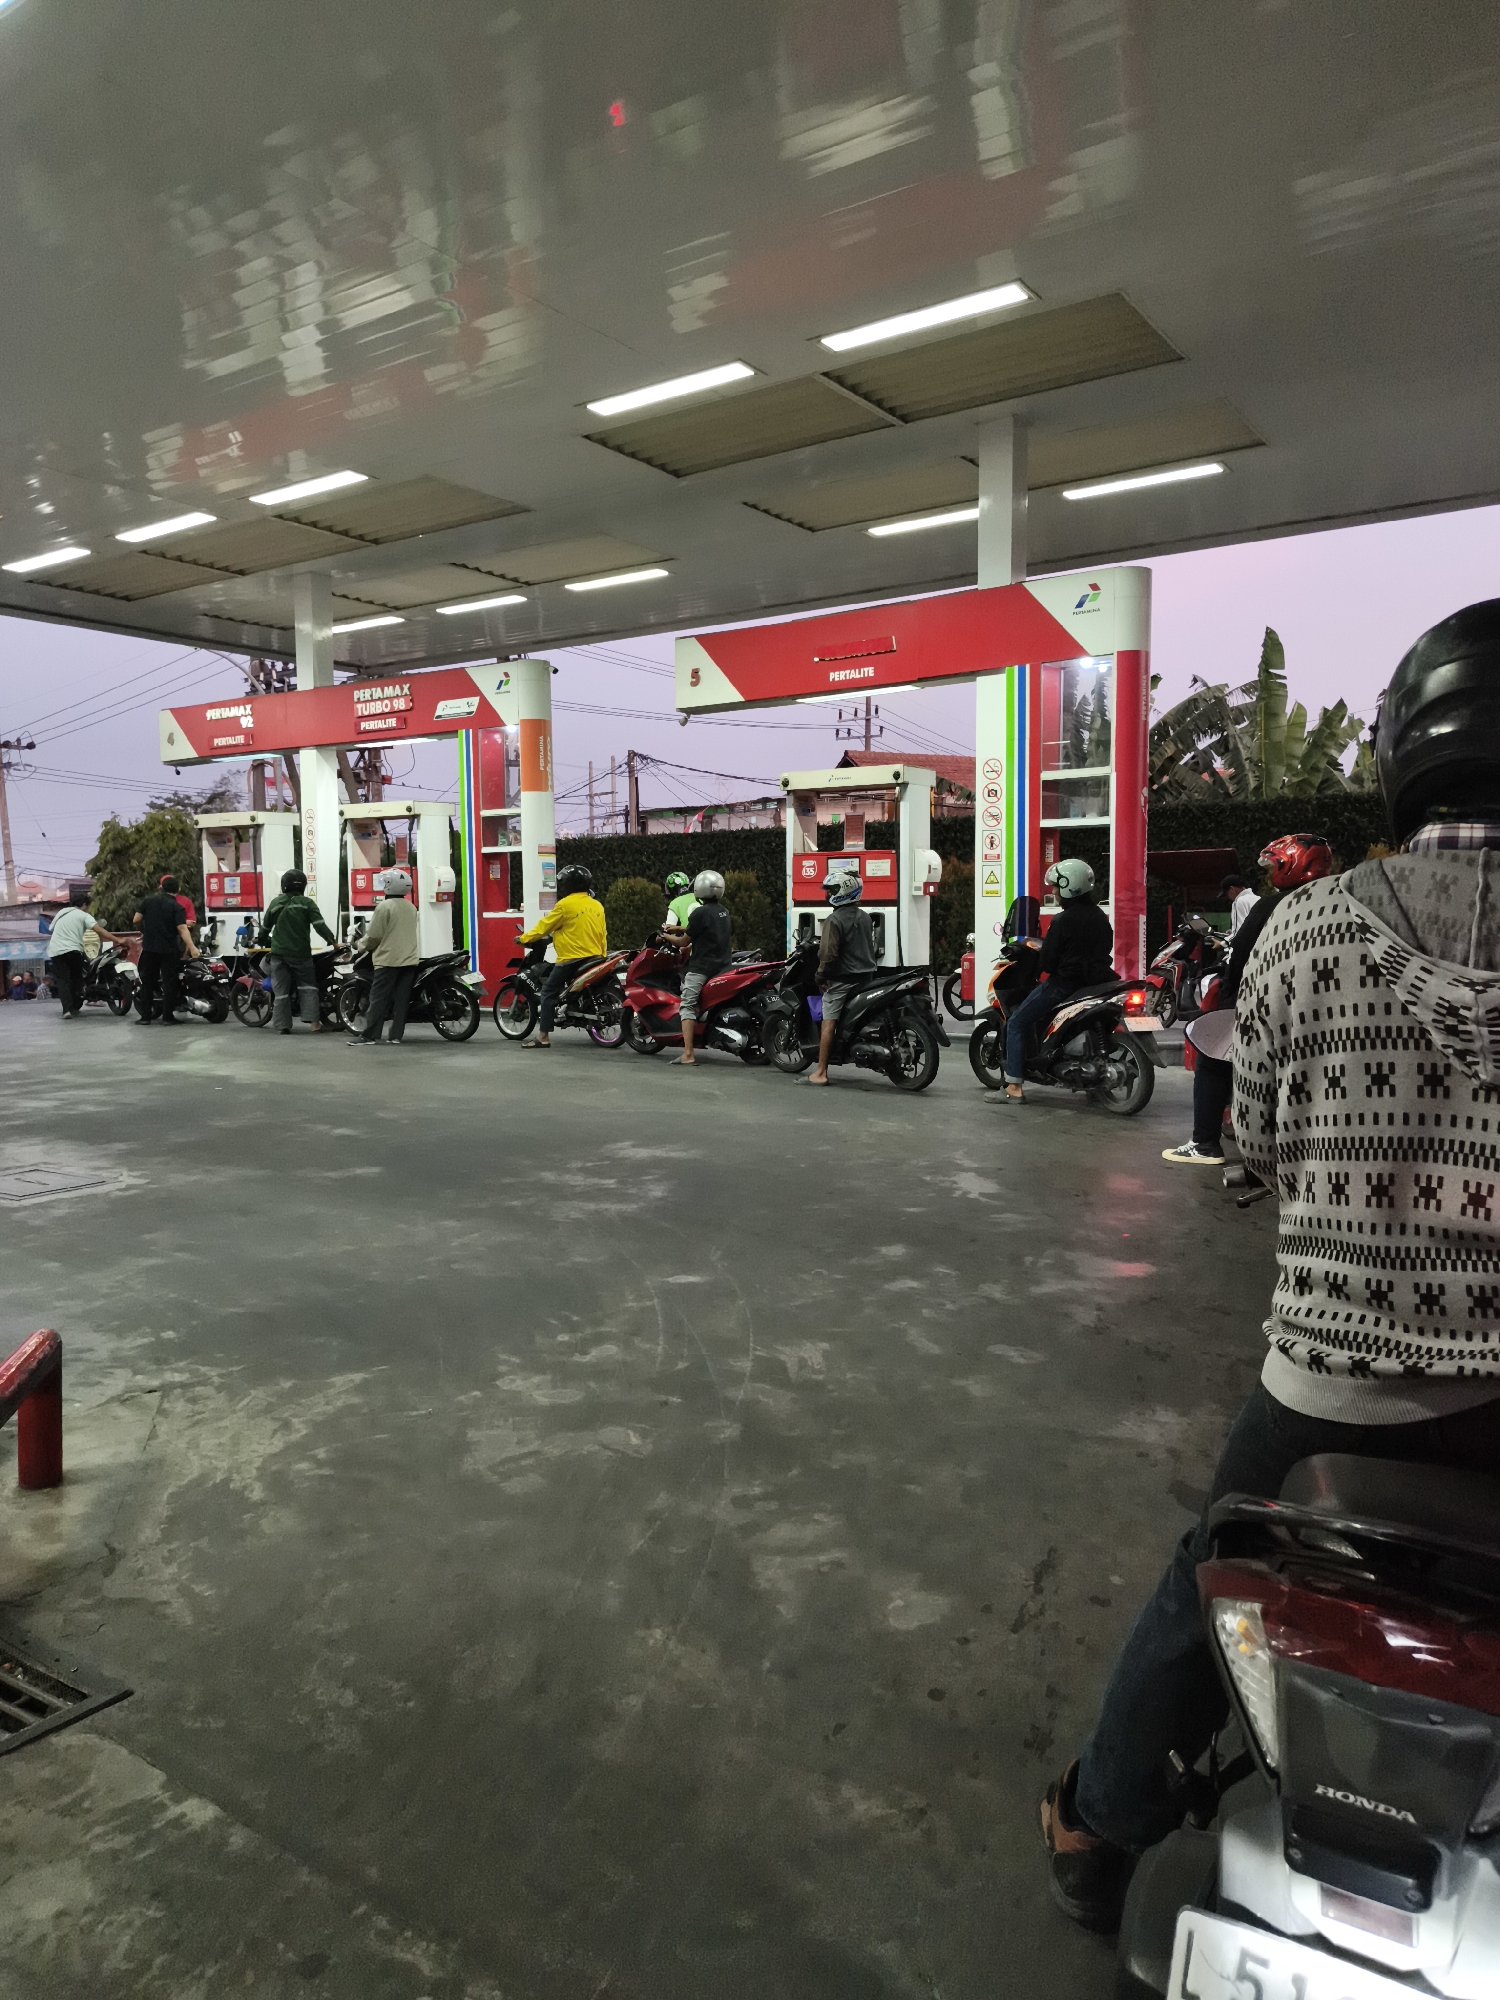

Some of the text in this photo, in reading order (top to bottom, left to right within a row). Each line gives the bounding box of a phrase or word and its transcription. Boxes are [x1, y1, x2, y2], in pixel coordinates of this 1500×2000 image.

[690, 667, 701, 687] 5
[829, 667, 875, 682] PERTALITE
[353, 684, 411, 702] PERTAMAX
[206, 704, 252, 721] PERTAMAX
[356, 699, 406, 717] TURBO 98
[240, 715, 254, 729] 92
[360, 718, 397, 731] PERTALITE
[213, 734, 245, 747] PERTALITE
[1315, 1783, 1418, 1825] HONDA
